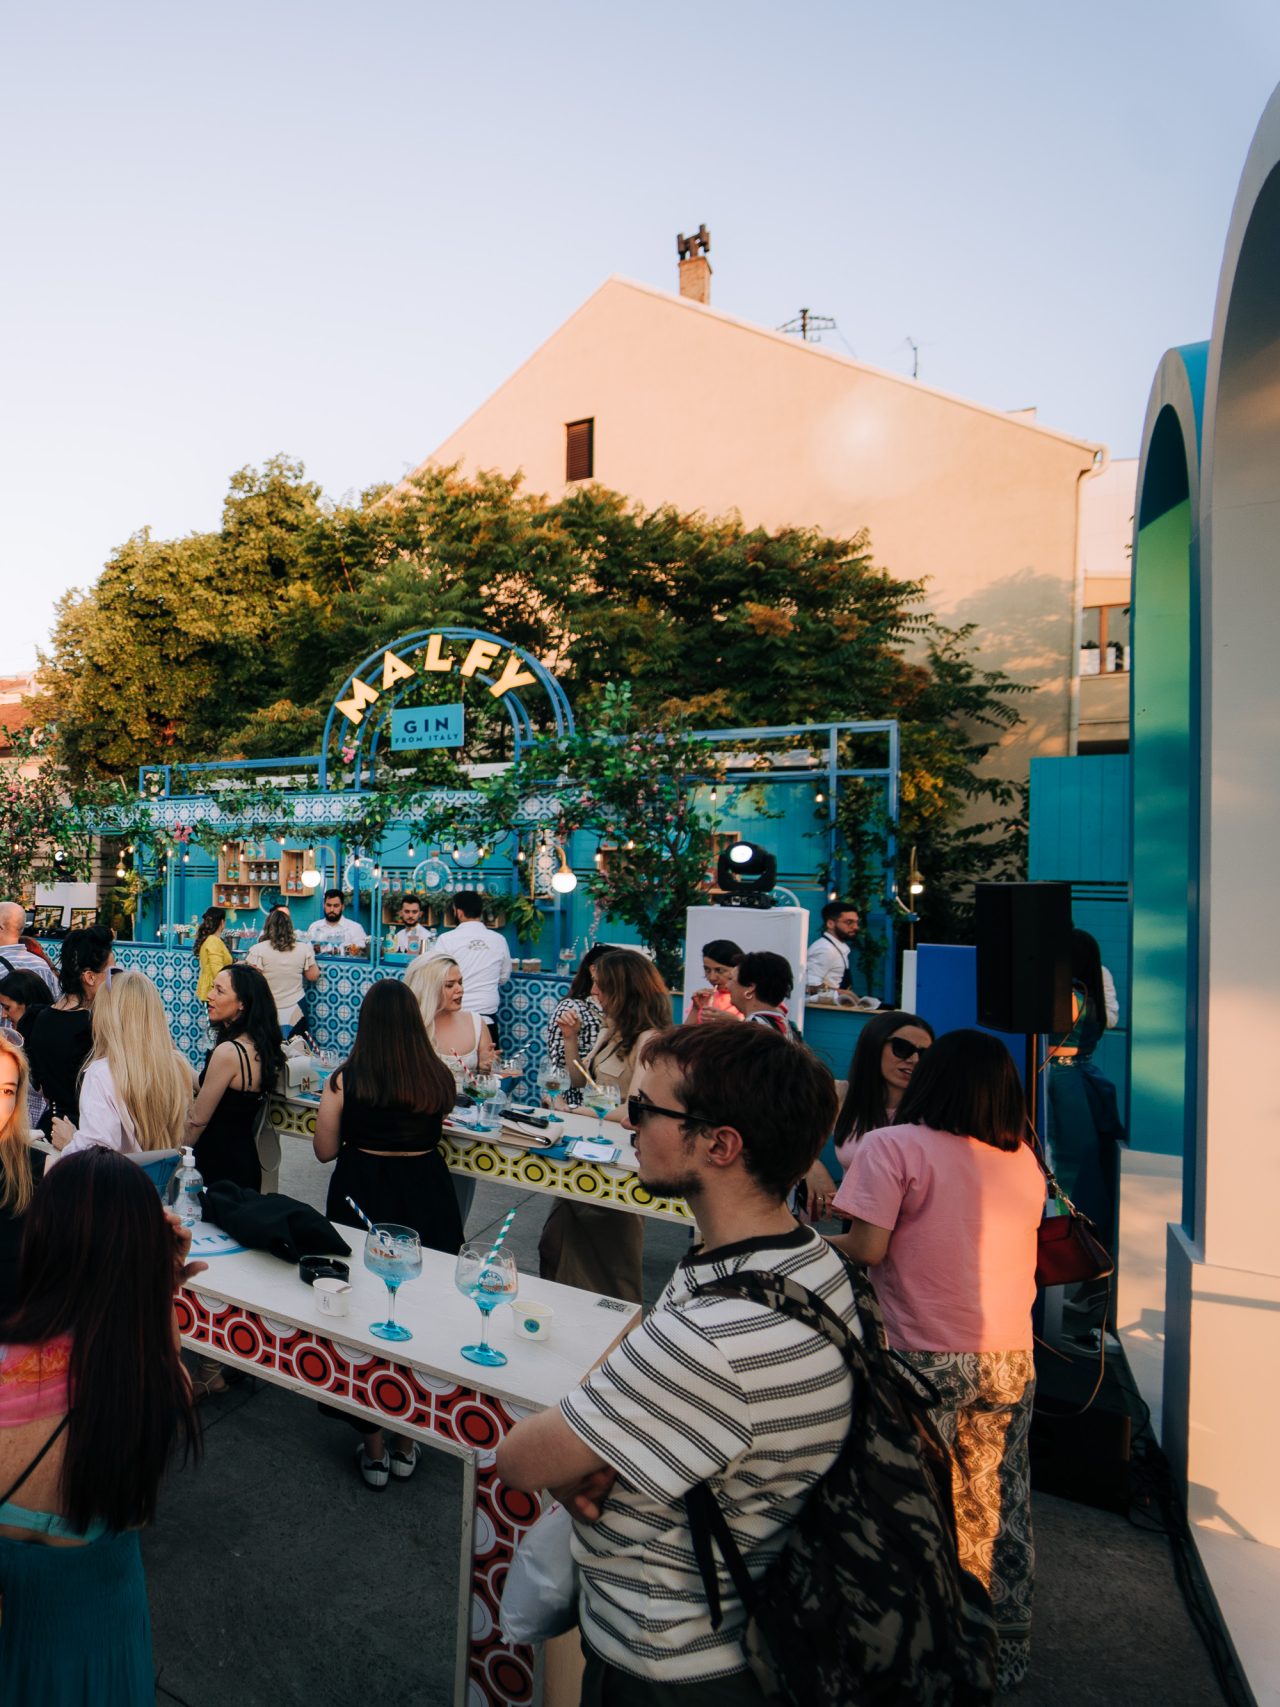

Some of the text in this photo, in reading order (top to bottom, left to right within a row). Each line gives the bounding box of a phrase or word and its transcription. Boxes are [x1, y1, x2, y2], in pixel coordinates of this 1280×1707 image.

[335, 634, 537, 725] MALFY
[403, 717, 449, 734] GIN
[394, 733, 460, 744] FROM ITALY
